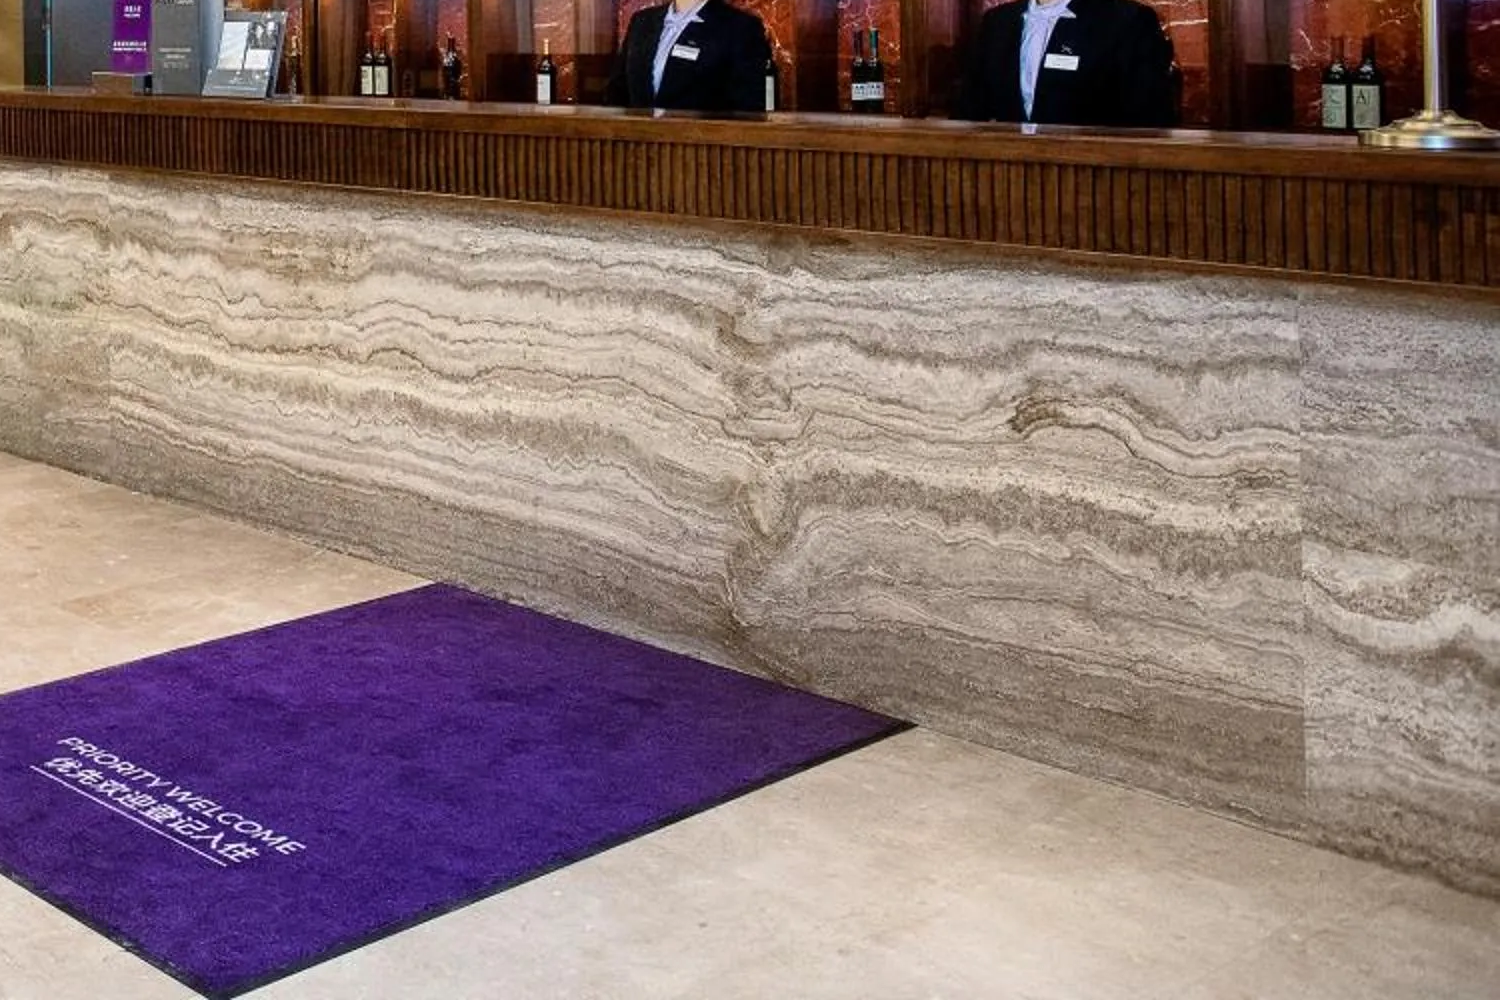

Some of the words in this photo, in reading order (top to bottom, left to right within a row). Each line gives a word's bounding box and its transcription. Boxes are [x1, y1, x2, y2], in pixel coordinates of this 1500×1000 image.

[44, 757, 260, 862] 优先欢迎登记入住
[57, 736, 172, 788] PRIORITY
[166, 786, 306, 855] WELCOME
